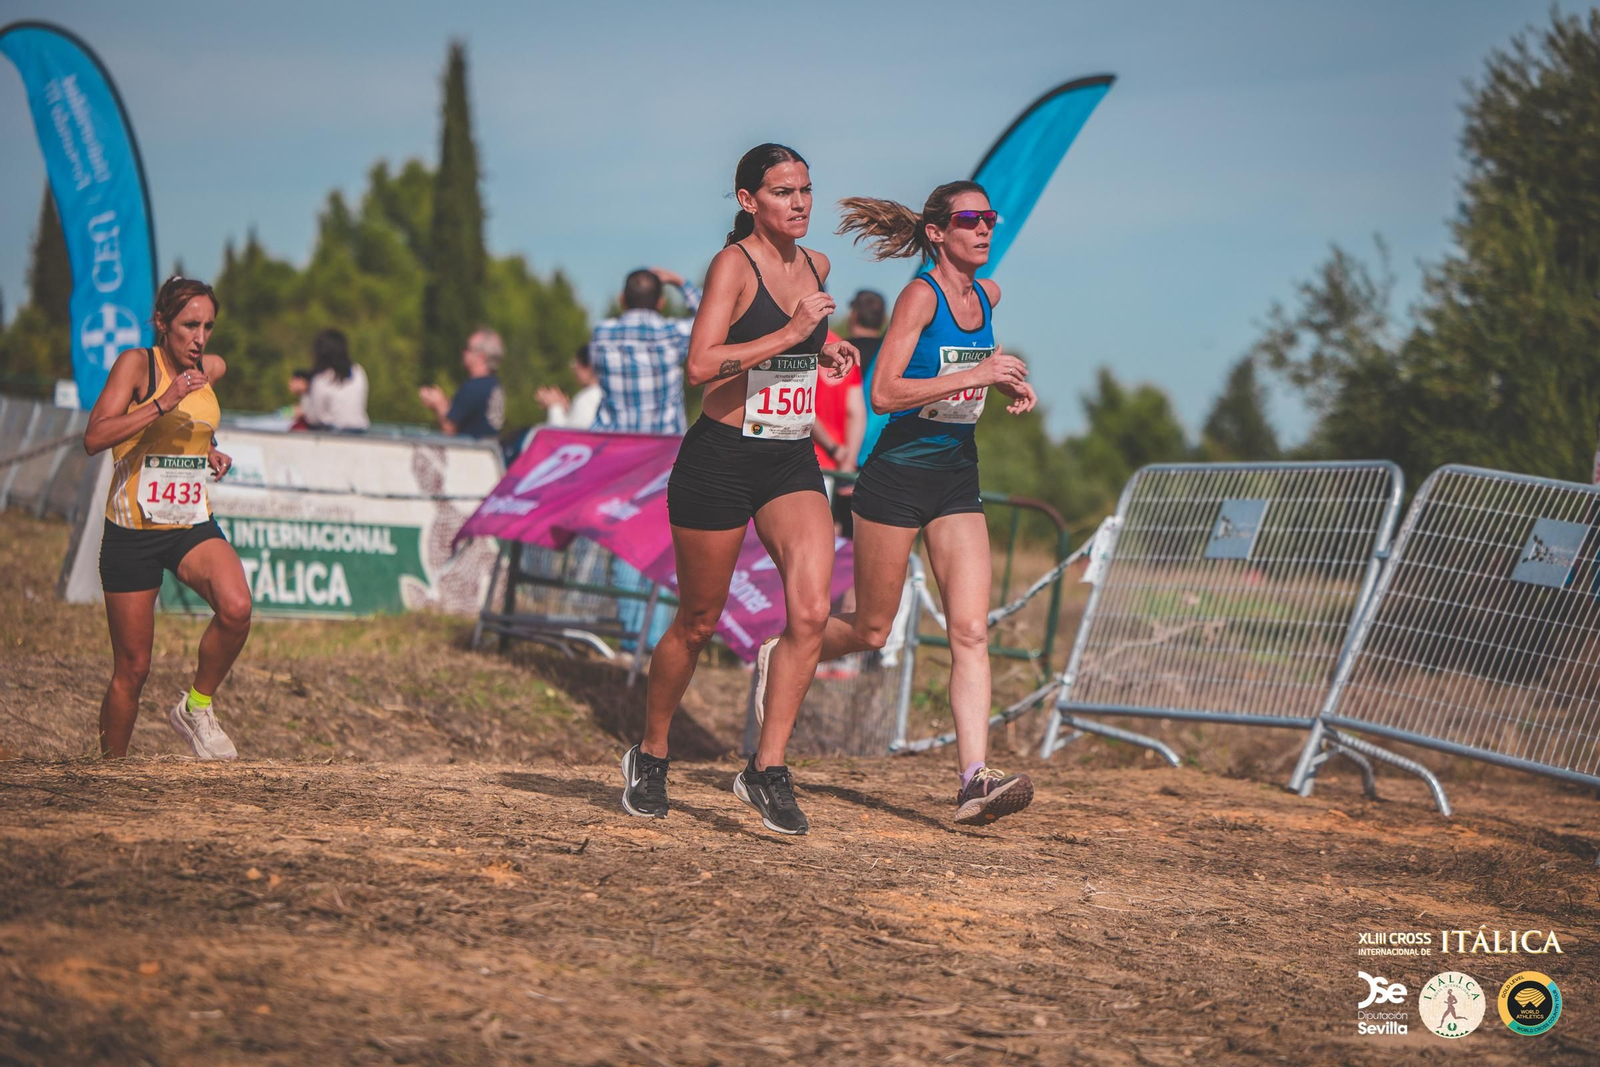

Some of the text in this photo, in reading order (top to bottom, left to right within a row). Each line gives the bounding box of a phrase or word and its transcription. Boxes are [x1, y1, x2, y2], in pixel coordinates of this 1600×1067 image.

[777, 358, 808, 369] ITÁLICA
[757, 386, 813, 415] 1501
[163, 457, 195, 469] ITÁLICA
[147, 481, 202, 505] 1433
[232, 519, 397, 555] INTERNACIONAL
[241, 549, 353, 607] TÁLICA
